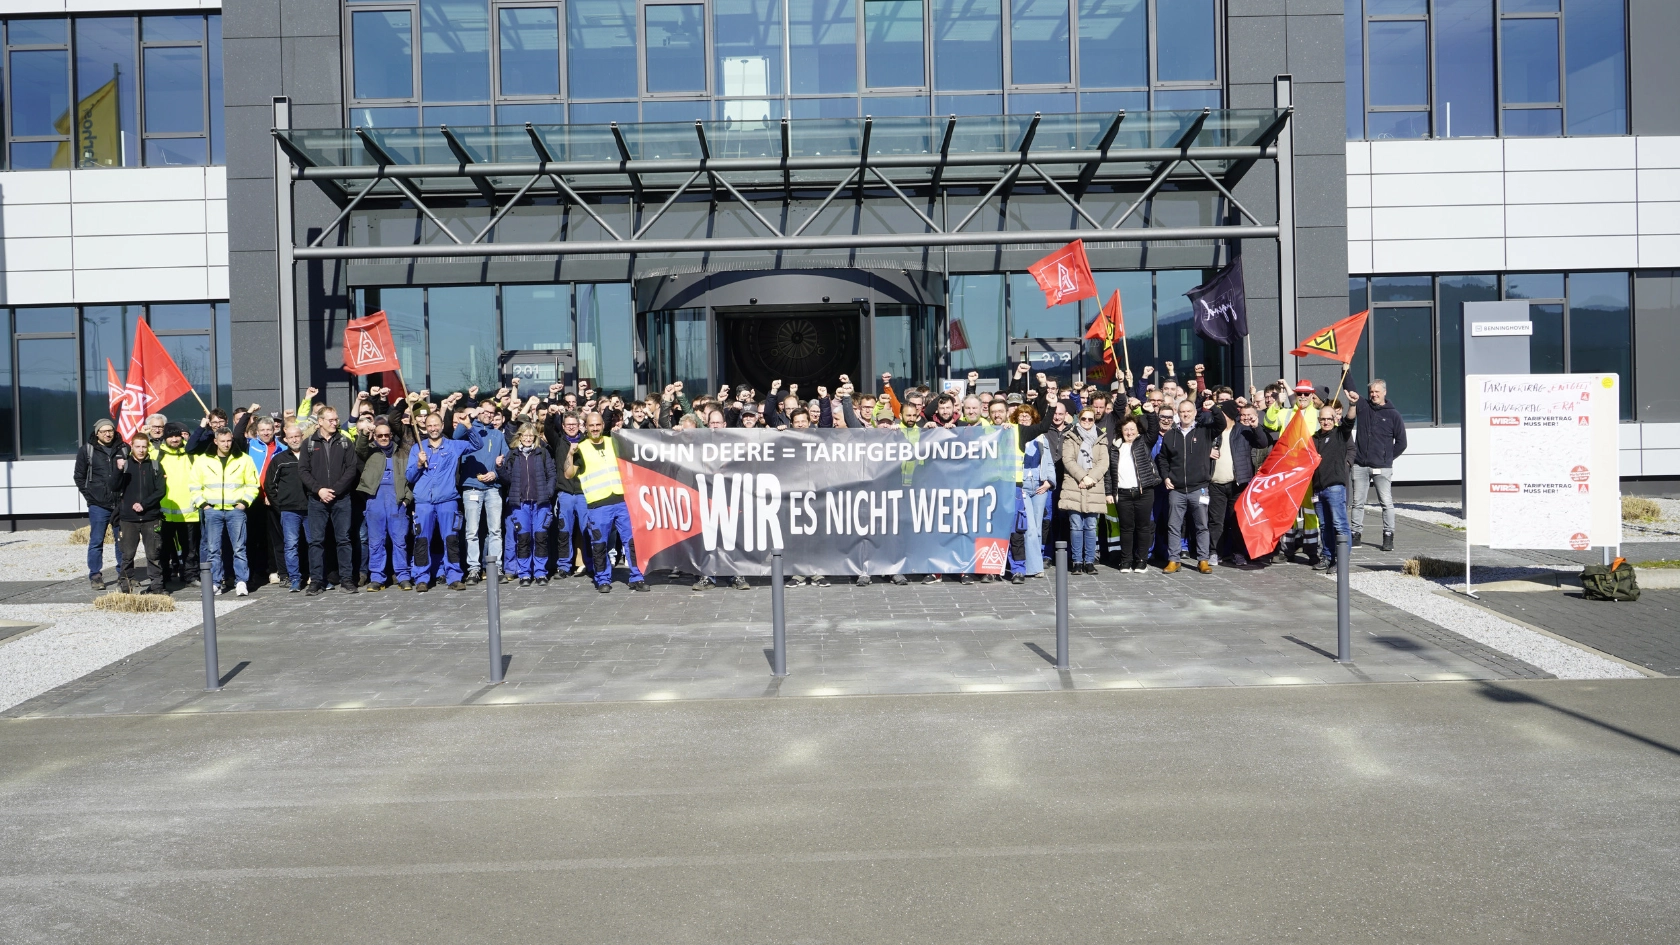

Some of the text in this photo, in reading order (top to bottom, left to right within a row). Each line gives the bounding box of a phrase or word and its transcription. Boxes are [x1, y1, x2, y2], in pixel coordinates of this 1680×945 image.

[514, 365, 540, 379] 201
[632, 440, 998, 463] JOHN DEERE = TARIFGEBUNDEN
[638, 473, 997, 552] SIND WIR ES NICHT WERT?
